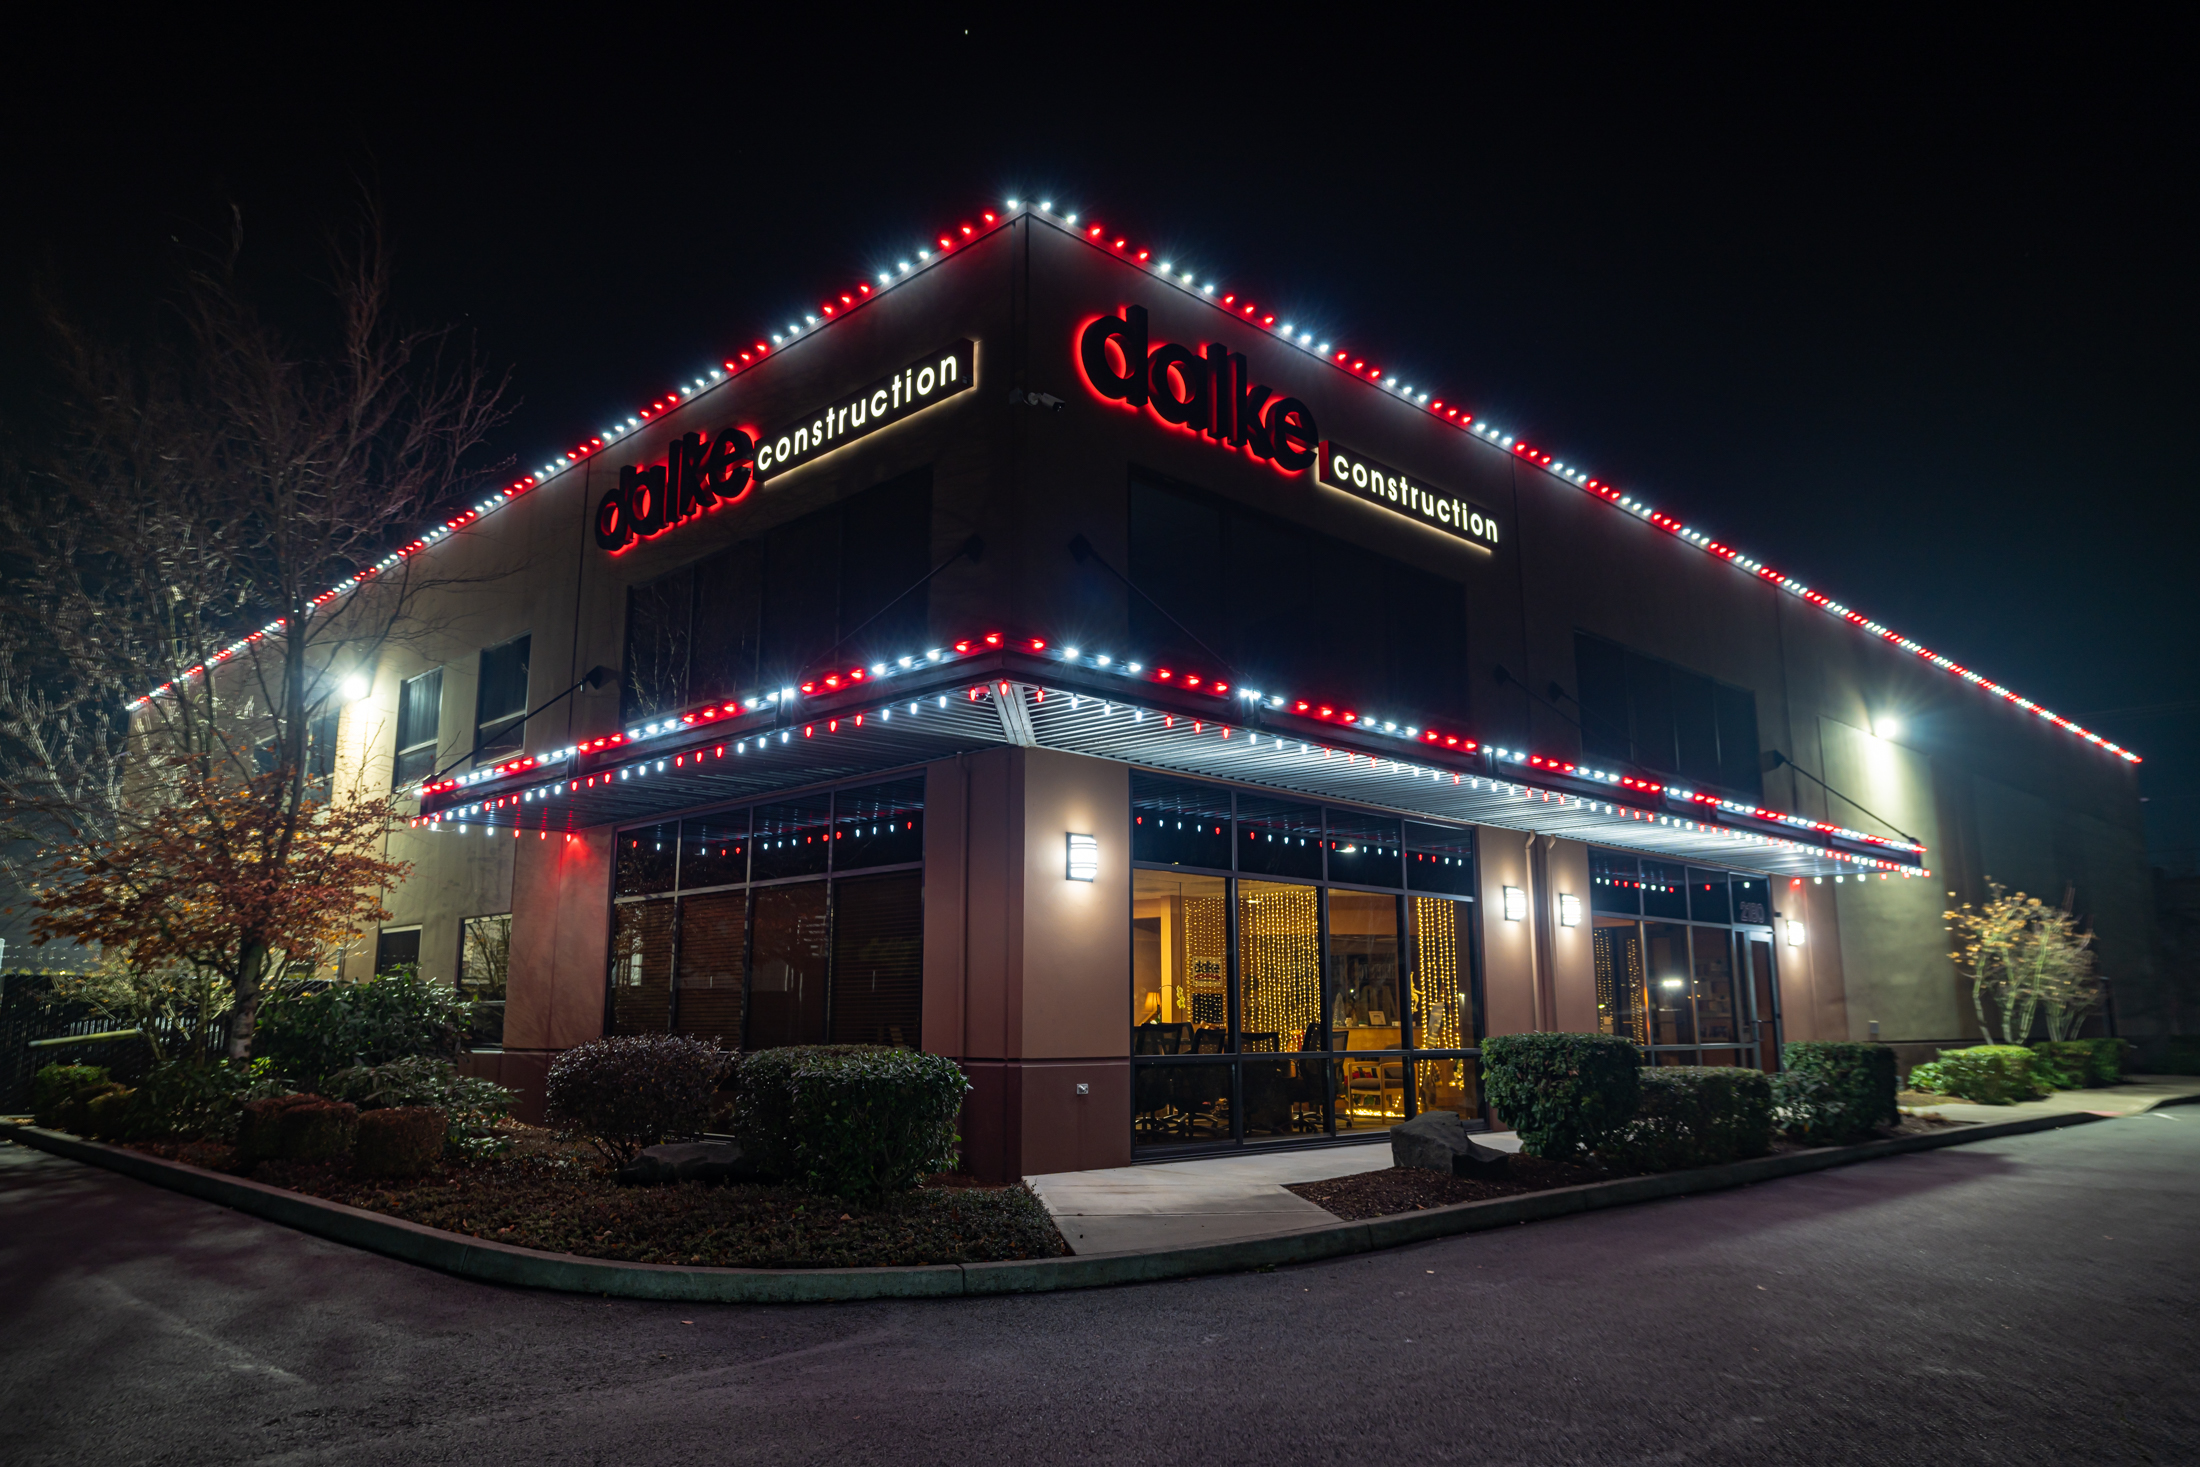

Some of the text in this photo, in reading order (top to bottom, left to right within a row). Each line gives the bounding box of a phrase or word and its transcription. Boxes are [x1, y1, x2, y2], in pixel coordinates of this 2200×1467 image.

[594, 354, 958, 551] dalke construction
[1080, 304, 1499, 543] dalke construction
